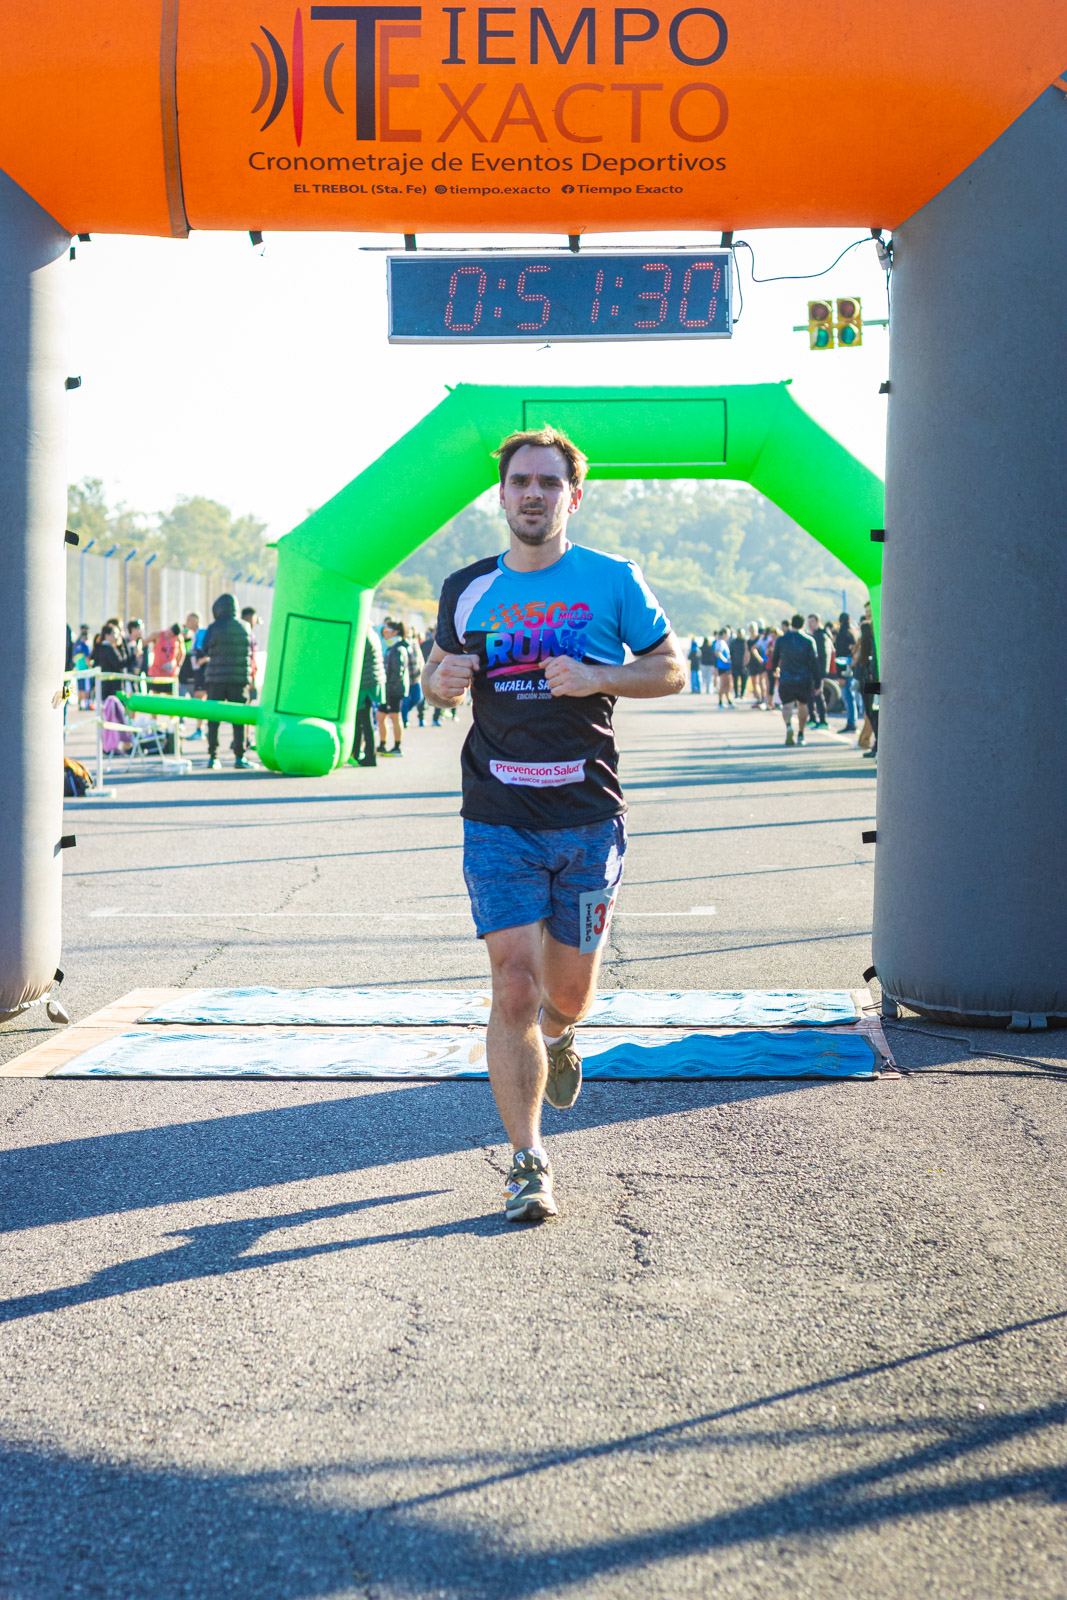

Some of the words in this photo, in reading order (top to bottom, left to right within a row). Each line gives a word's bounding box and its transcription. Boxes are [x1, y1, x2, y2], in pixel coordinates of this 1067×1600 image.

[379, 25, 729, 144] EXACTO
[248, 152, 424, 176] Cronometraje
[431, 152, 463, 172] de
[471, 152, 573, 172] Eventos
[582, 152, 727, 176] Deportivos
[293, 184, 310, 194] EL
[312, 184, 368, 194] TREBOL
[371, 184, 403, 195] (Sta.
[406, 184, 427, 195] Fe)
[450, 184, 551, 196] tiempo.exacto
[577, 184, 632, 195] Tiempo
[635, 184, 684, 194] Exacto
[522, 601, 591, 630] 500
[558, 611, 594, 621] MILLAS
[485, 629, 572, 668] RUN
[494, 680, 535, 693] RAFAELA,
[495, 763, 552, 776] Prevención
[553, 763, 580, 776] Salud
